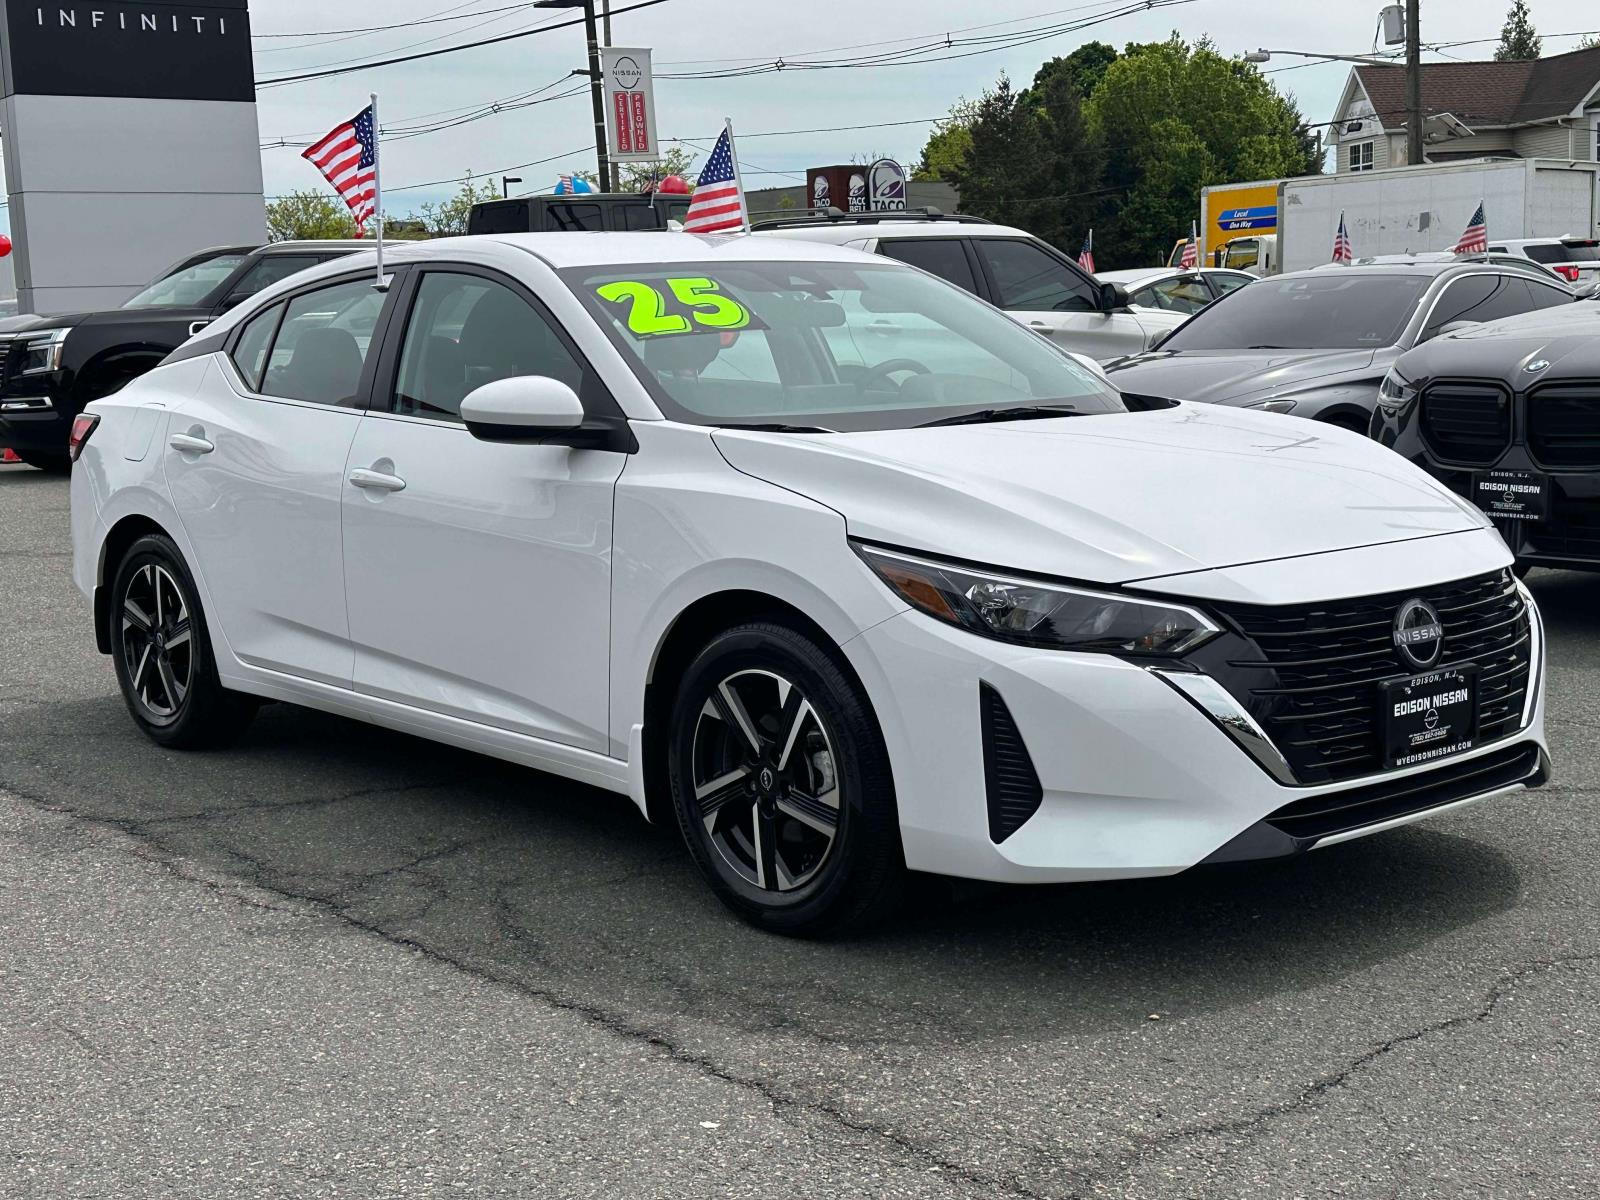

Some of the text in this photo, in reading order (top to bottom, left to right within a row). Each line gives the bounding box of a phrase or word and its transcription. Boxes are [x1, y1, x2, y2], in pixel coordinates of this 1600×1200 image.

[37, 8, 225, 35] INFINITI
[618, 95, 628, 149] CERTIFIED
[635, 95, 645, 149] PREOWNED
[813, 199, 830, 207] TACO
[872, 200, 905, 211] TACO
[596, 277, 750, 336] 25
[1480, 482, 1540, 494] EDISON NISSAN
[1397, 626, 1442, 644] NISSAN
[1411, 670, 1459, 687] EDISON, N.J.
[1394, 688, 1468, 717] EDISON NISSAN
[1396, 740, 1472, 766] MYEDISONNISSAN.COM
